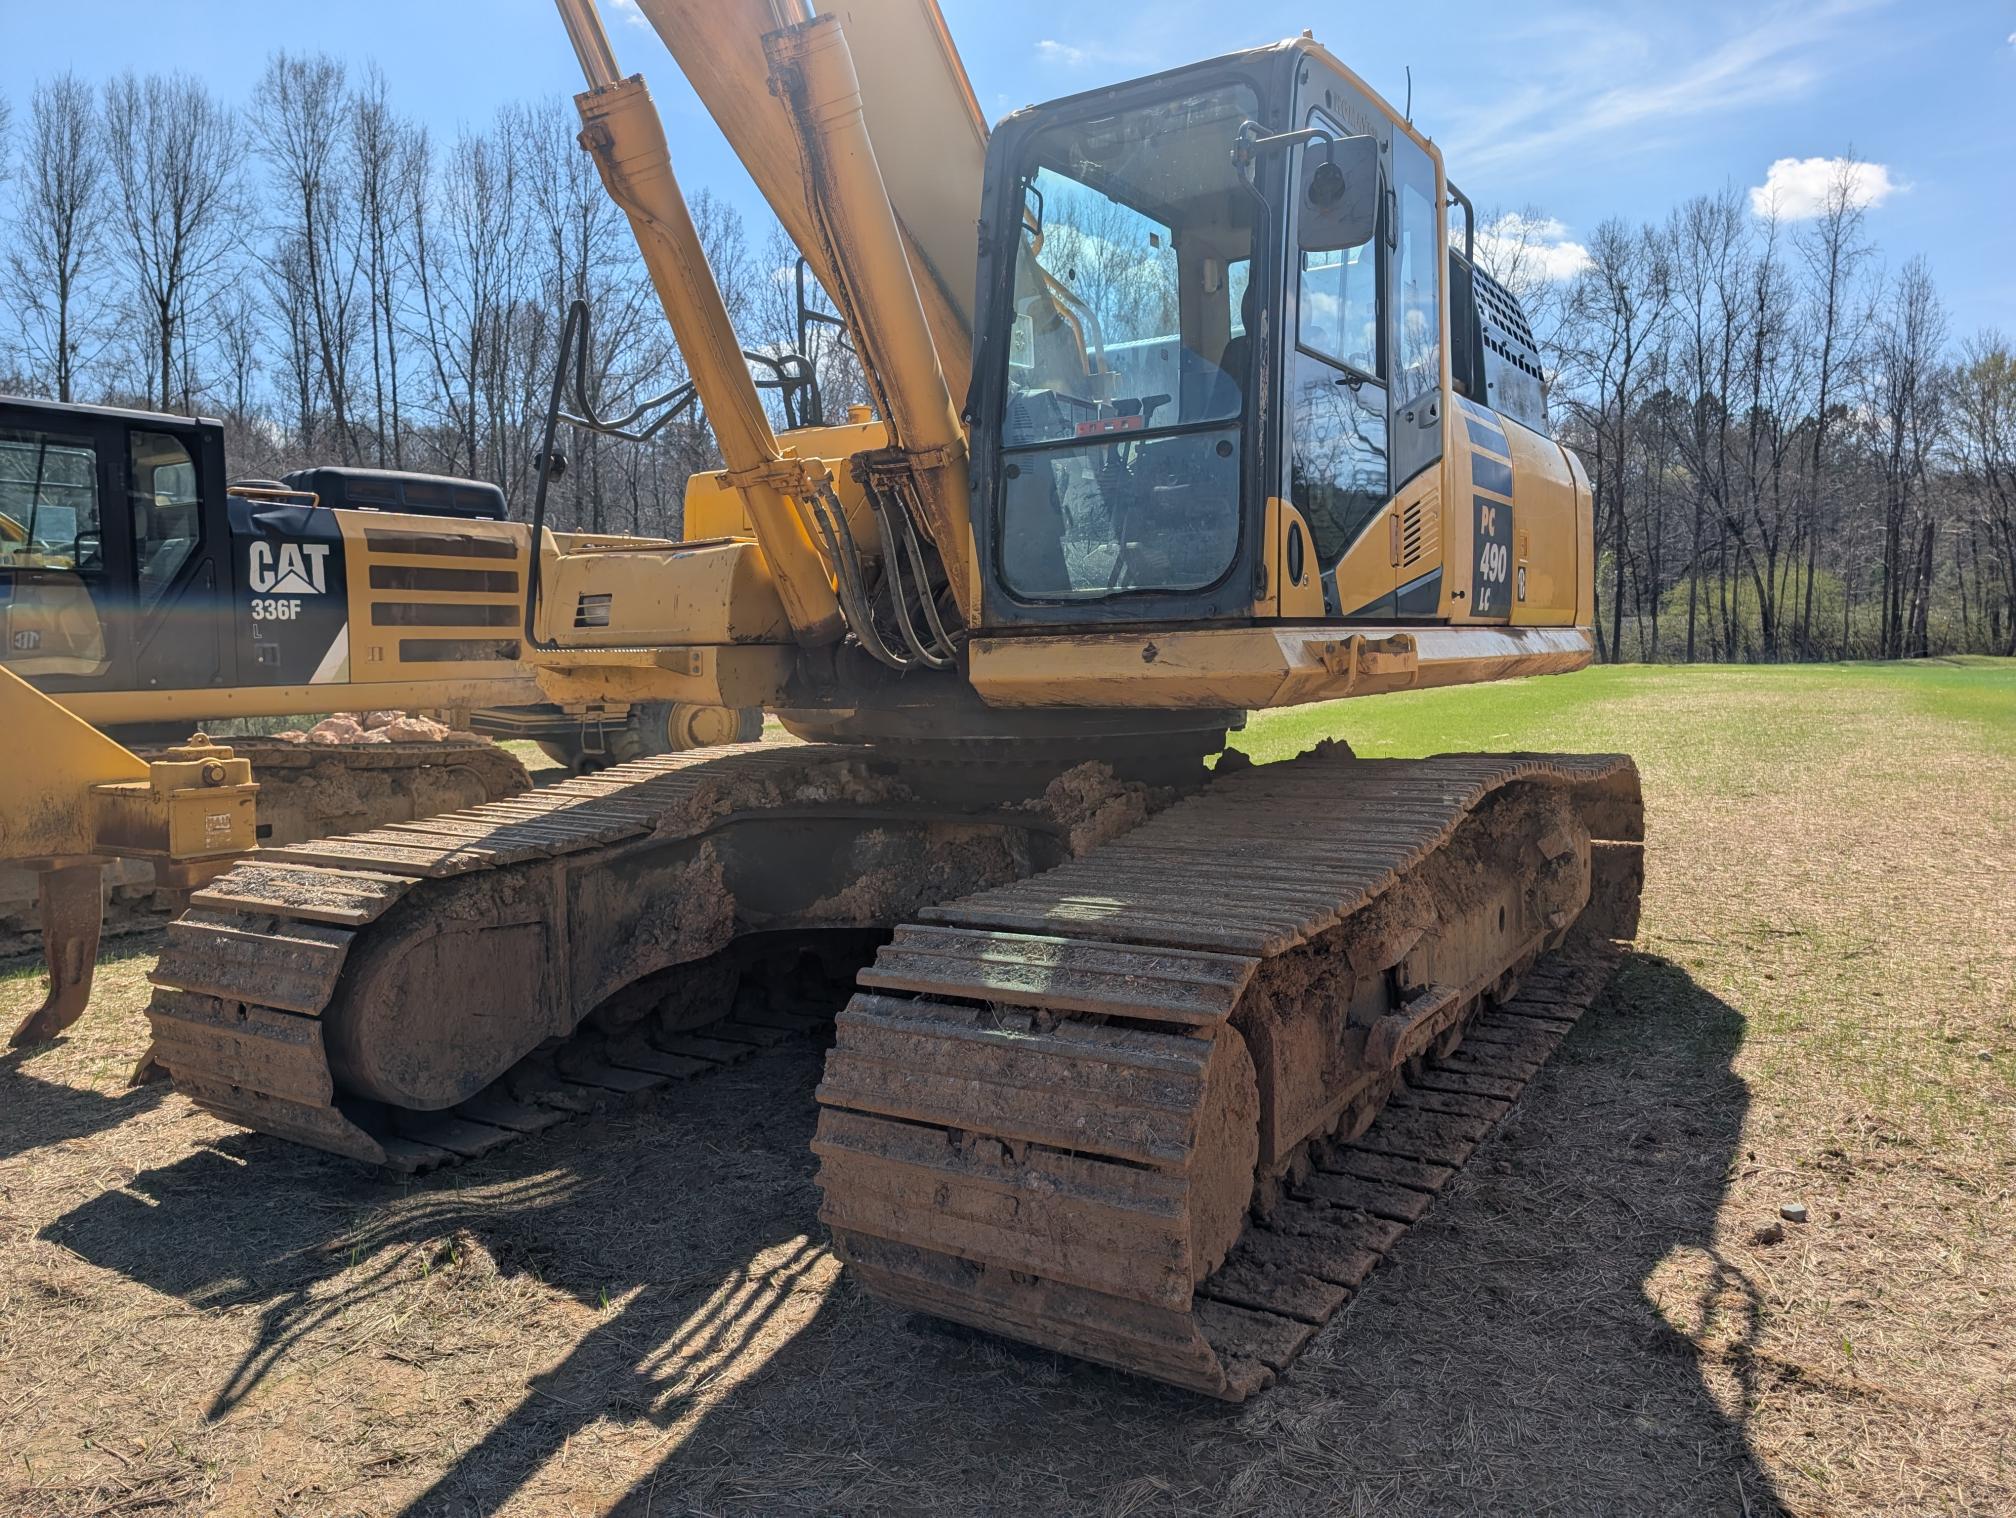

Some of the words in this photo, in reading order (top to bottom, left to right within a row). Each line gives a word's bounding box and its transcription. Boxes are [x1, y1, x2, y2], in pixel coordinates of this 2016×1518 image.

[1481, 505, 1495, 536] PC
[249, 541, 330, 594] CAT
[1480, 542, 1507, 584] 490
[251, 599, 302, 620] 336F
[1478, 587, 1491, 611] LC
[253, 624, 263, 639] L
